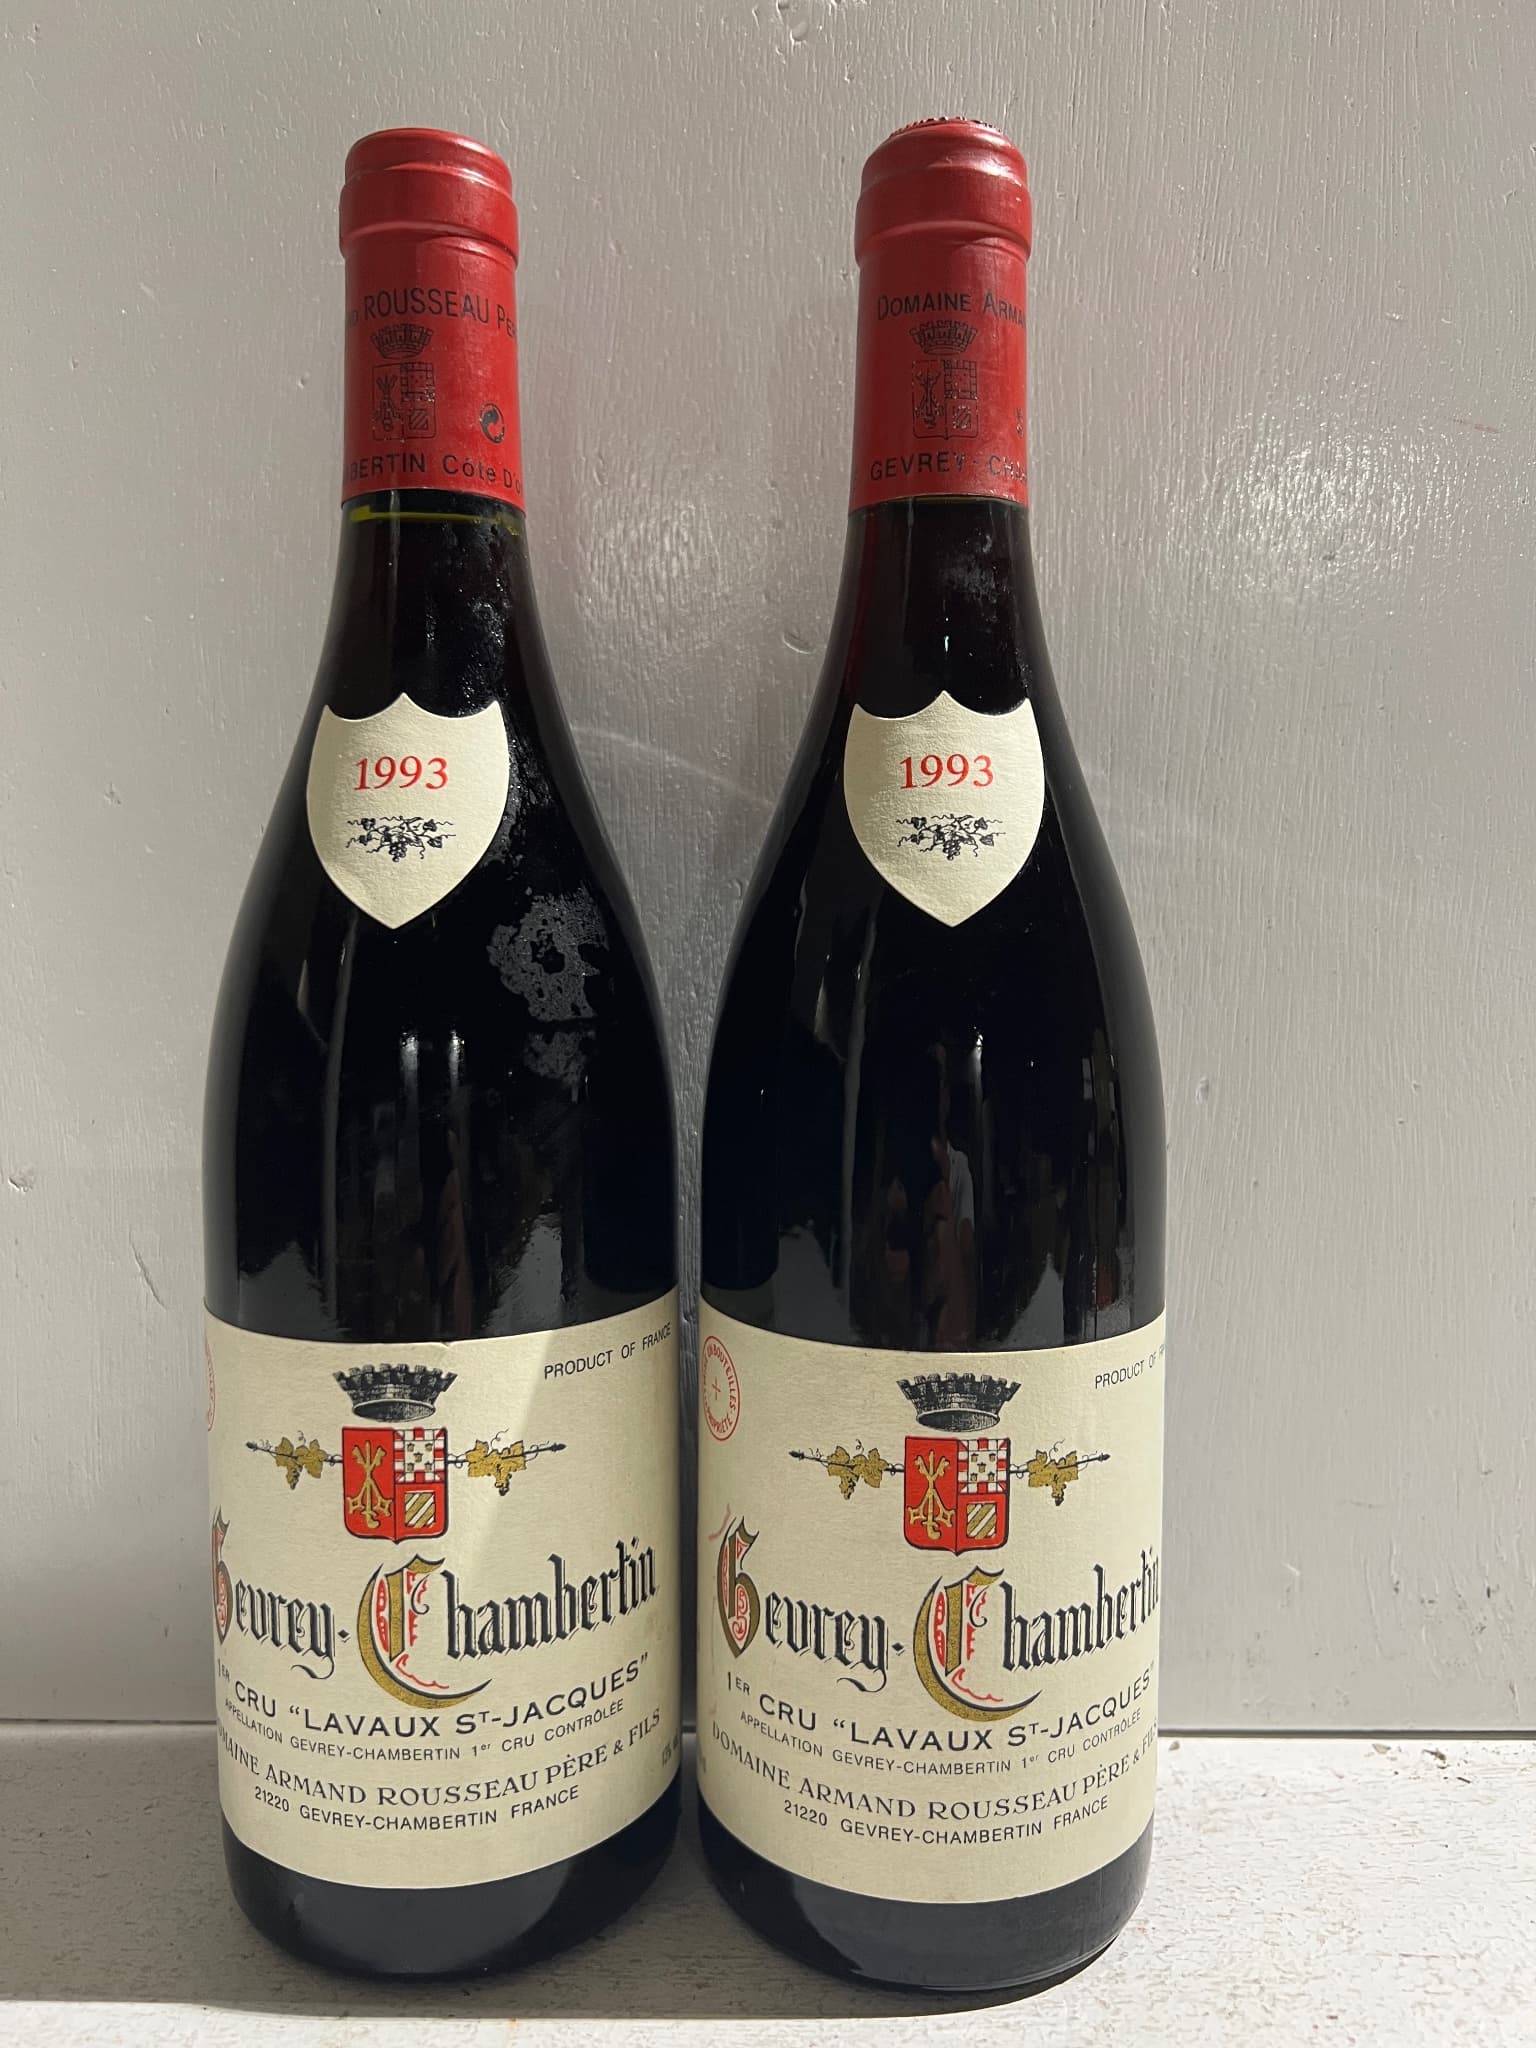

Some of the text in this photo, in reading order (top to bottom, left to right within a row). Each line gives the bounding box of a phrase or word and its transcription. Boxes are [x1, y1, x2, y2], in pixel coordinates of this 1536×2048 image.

[364, 288, 490, 324] ROUSSEAU
[983, 289, 1027, 329] ARMA
[349, 452, 426, 481] BERTIN
[353, 755, 449, 791] 1993
[899, 753, 994, 789] 1993
[544, 1349, 614, 1380] PRODUCT
[621, 1341, 637, 1360] OF
[642, 1322, 672, 1351] FRANCE
[1095, 1359, 1145, 1390] PRODUCT
[235, 1680, 276, 1718] CRU
[759, 1693, 817, 1731] CRU
[225, 1697, 283, 1744] APPELLATION
[290, 1735, 461, 1761] GEVREY-CHAMBERTIN
[471, 1743, 492, 1758] 1er
[501, 1733, 535, 1752] CRU
[739, 1710, 824, 1758] APPELLATION
[832, 1749, 1011, 1776] GEVREY-CHAMBERTIN
[1048, 1743, 1076, 1764] CRU
[265, 1763, 367, 1804] ARMAND
[376, 1771, 539, 1807] ROUSSEAU
[546, 1743, 609, 1785] PÈRE
[613, 1739, 624, 1755] &
[629, 1707, 661, 1747] FILS
[712, 1720, 791, 1790] DOMAINE
[799, 1777, 916, 1818] ARMAND
[928, 1781, 1077, 1821] ROUSSEAU
[1082, 1753, 1130, 1795] PÈRE
[1133, 1749, 1140, 1765] &
[254, 1784, 580, 1831] 21220 GEVREY-CHAMBERTIN FRANCE
[784, 1794, 1109, 1846] 21220 GEVREY-CHAMBERTIN FRANCE
